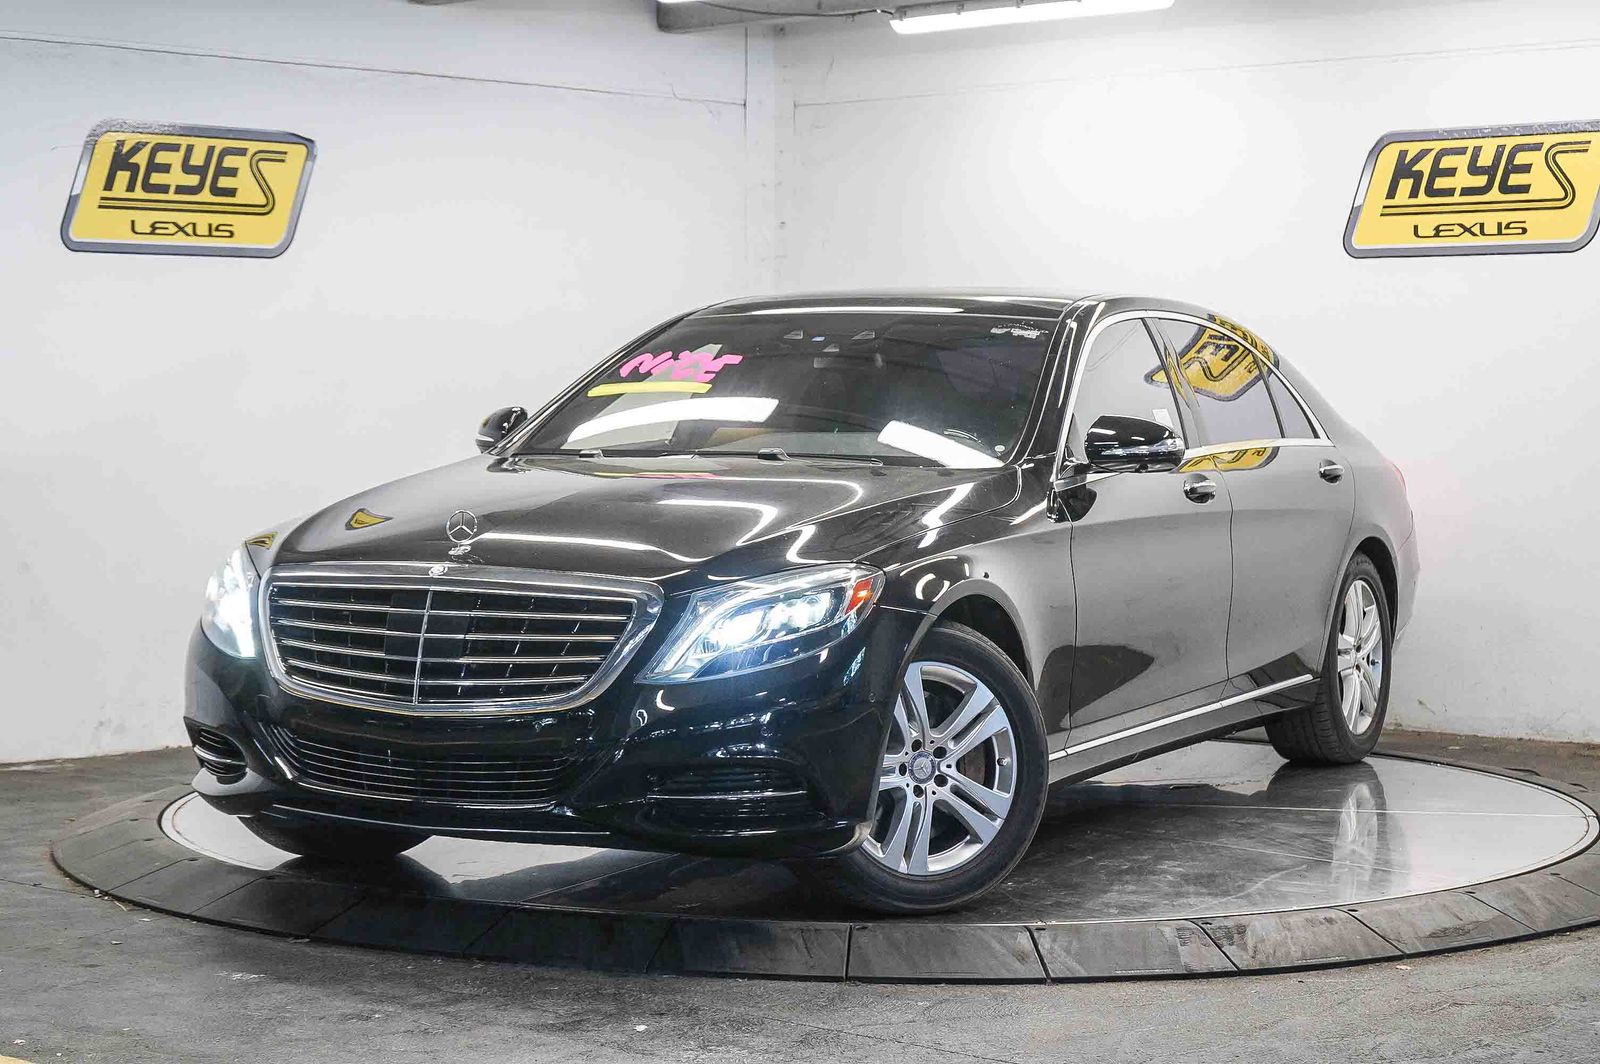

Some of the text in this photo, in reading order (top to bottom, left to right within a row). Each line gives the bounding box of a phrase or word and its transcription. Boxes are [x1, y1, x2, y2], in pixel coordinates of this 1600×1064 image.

[100, 138, 288, 216] KEYES
[1382, 140, 1592, 217] KEYES
[130, 219, 235, 239] LEXUS
[1413, 220, 1528, 239] LEXUS
